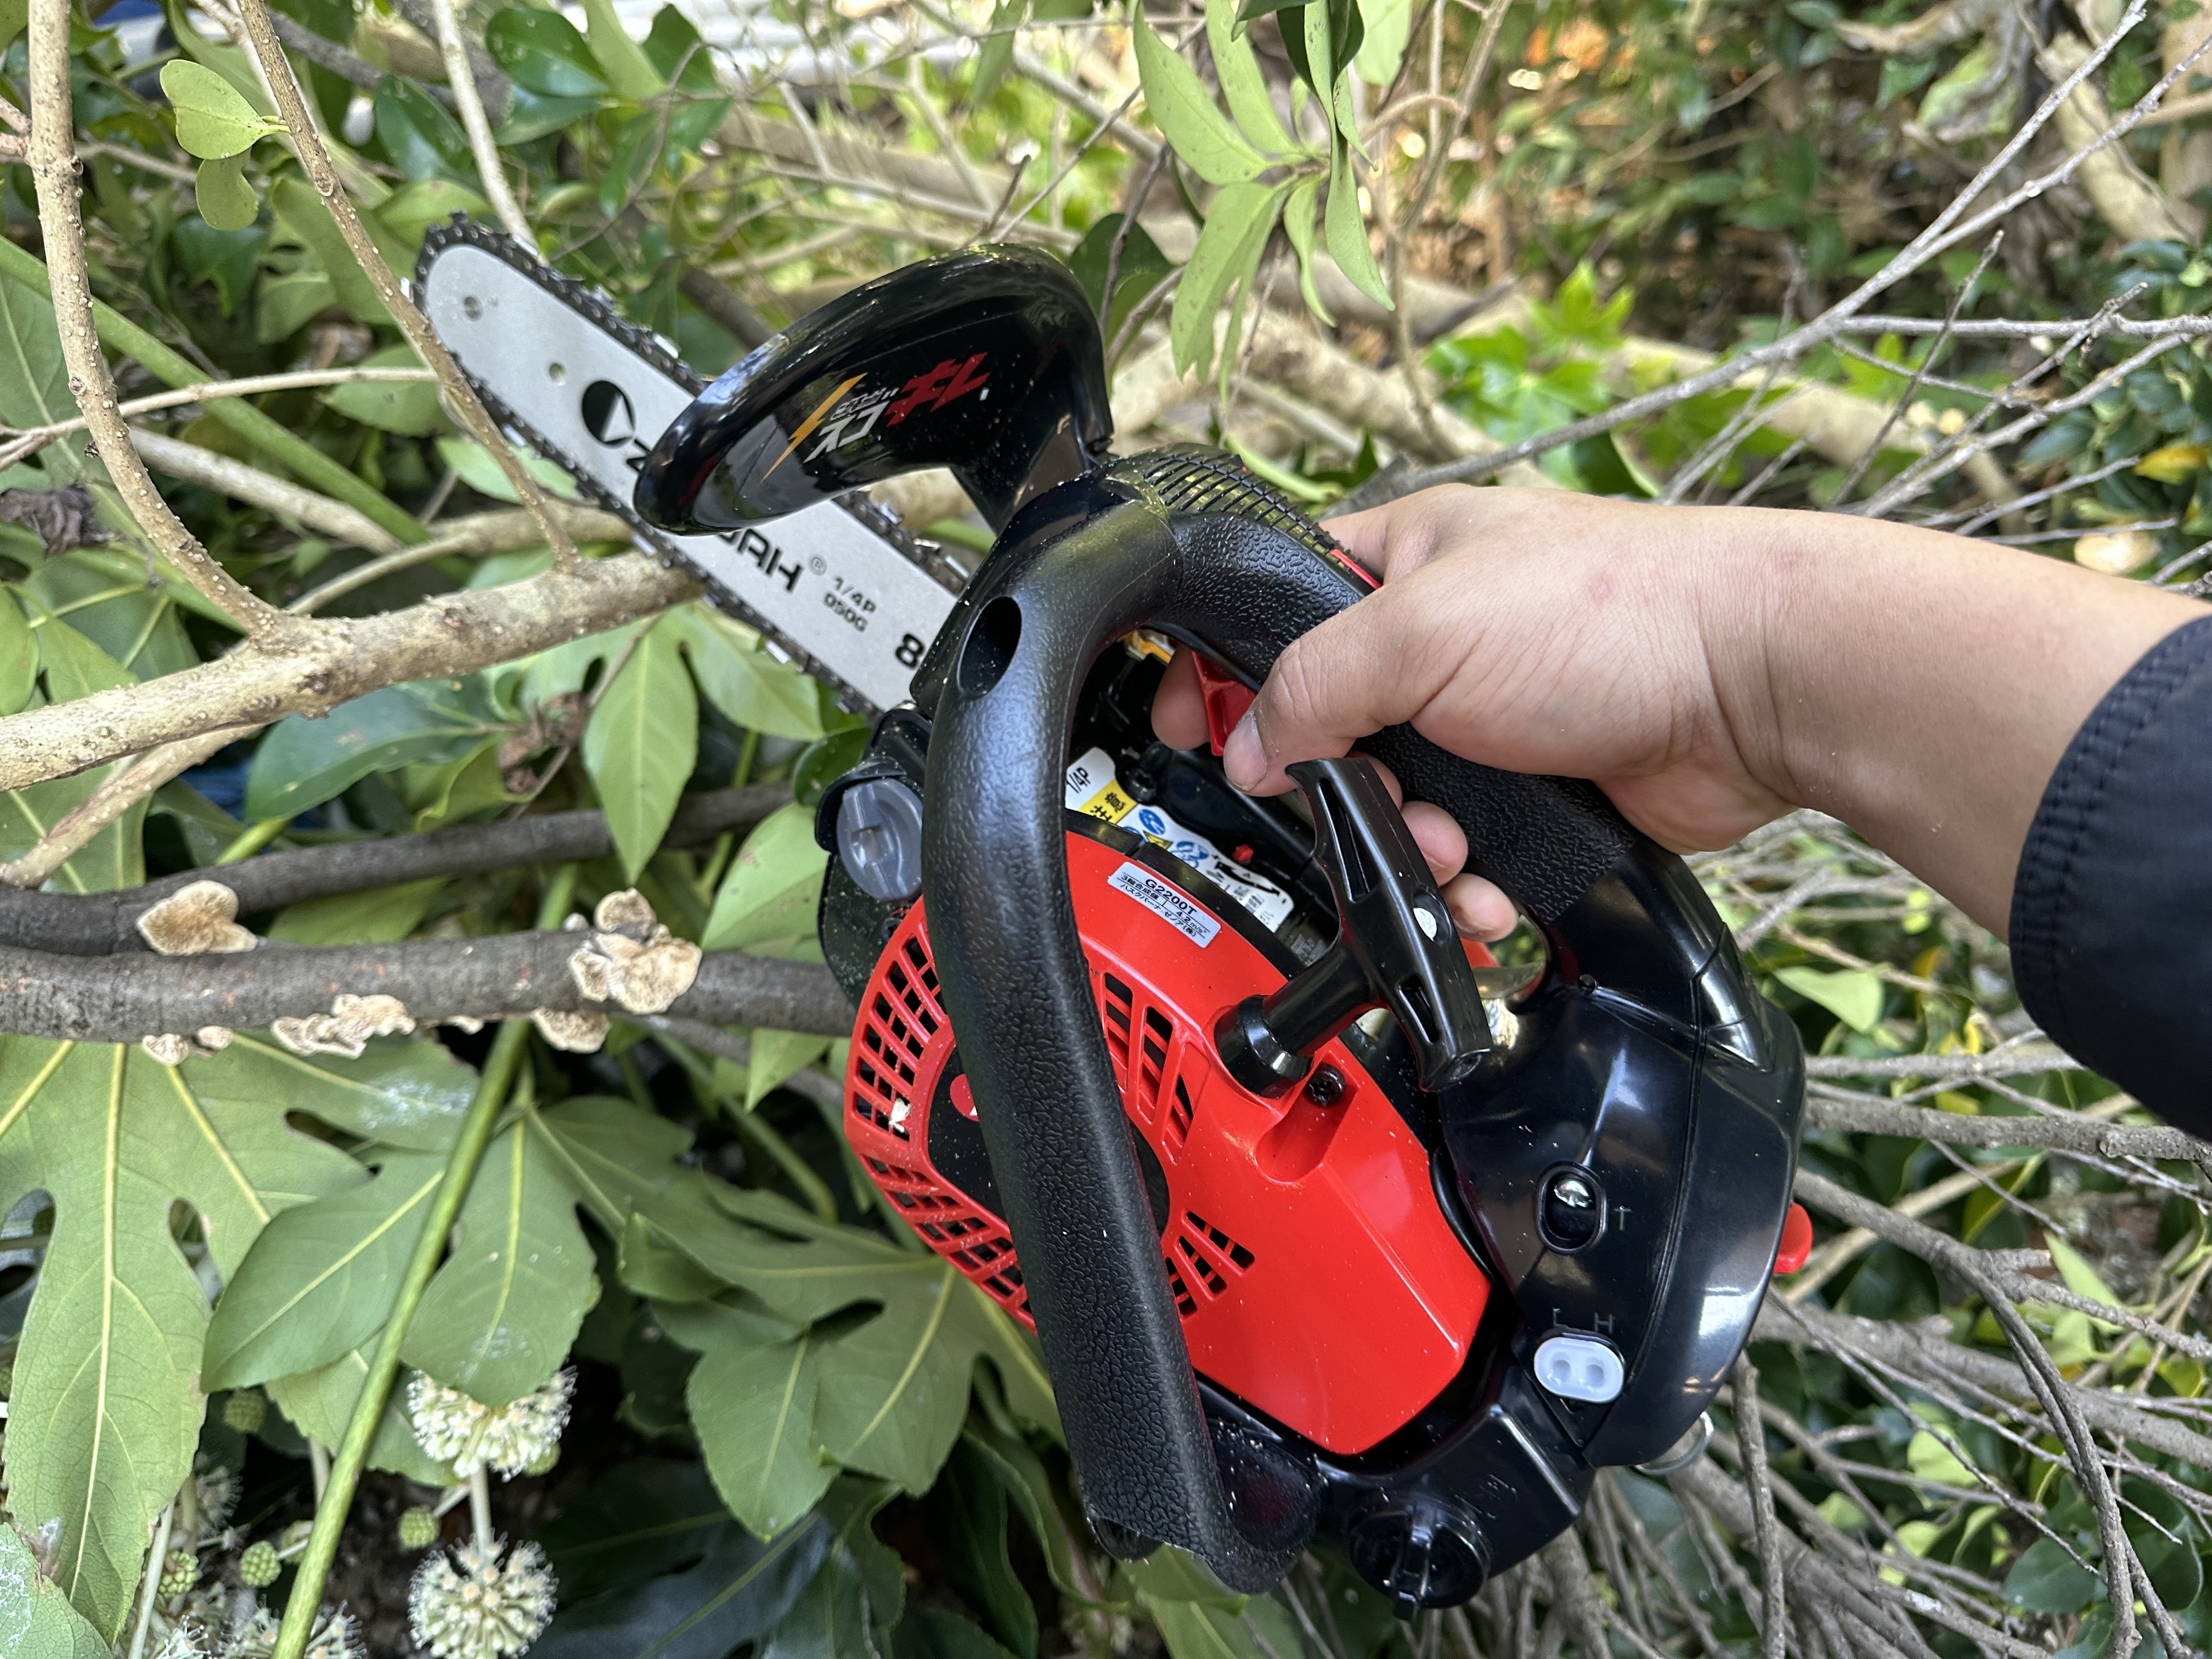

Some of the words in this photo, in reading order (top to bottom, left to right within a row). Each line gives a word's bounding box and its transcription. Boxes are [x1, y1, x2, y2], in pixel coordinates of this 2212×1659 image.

[833, 575, 877, 614] 1/4P
[824, 592, 868, 633] 050G
[895, 633, 925, 670] 8
[1066, 766, 1091, 794] 1/4P
[1090, 792, 1126, 822] 注意
[1145, 879, 1198, 915] G2200T
[1176, 911, 1191, 923] 4.2
[1613, 1205, 1632, 1231] T
[1594, 1311, 1613, 1334] H
